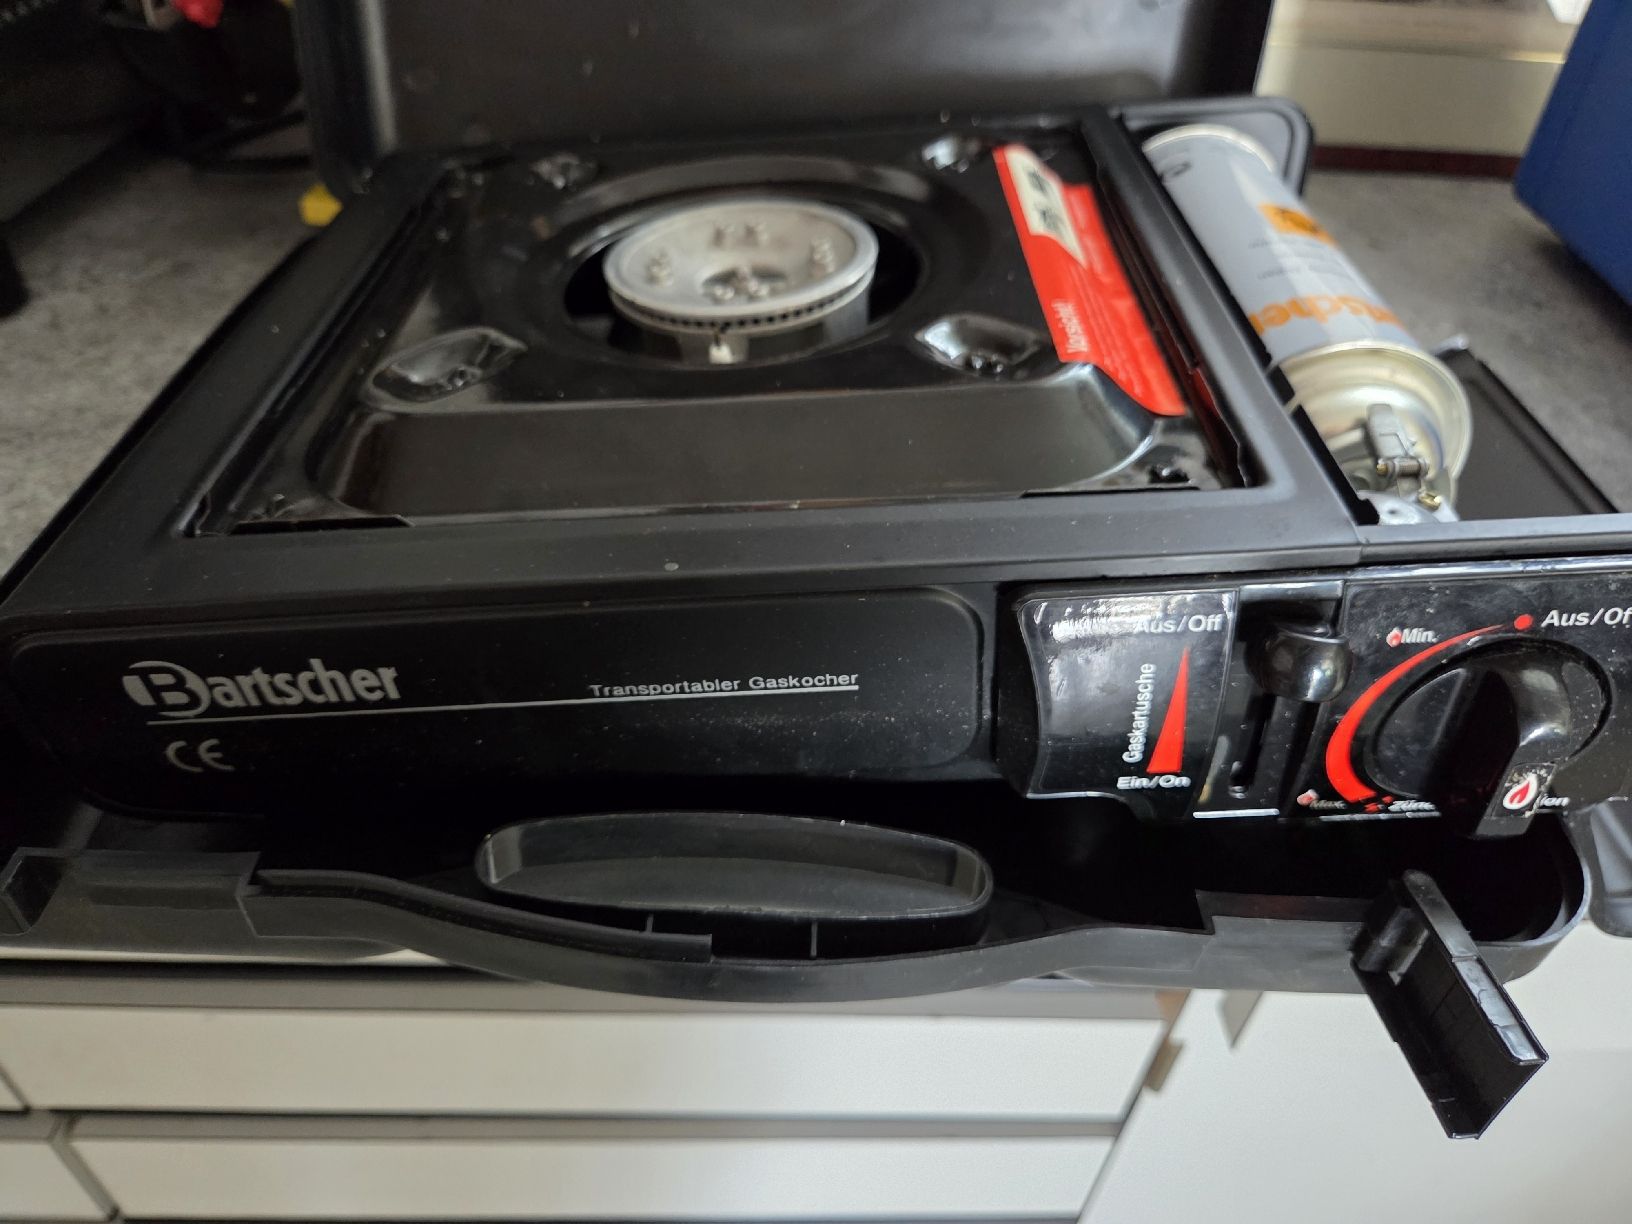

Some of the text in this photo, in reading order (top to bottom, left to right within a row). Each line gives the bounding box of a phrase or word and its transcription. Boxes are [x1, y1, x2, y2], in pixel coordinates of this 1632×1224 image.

[1133, 613, 1224, 634] Aus/Off
[1540, 607, 1632, 628] Aus/Of
[1400, 627, 1438, 644] Min.
[122, 658, 401, 718] Bartscher
[588, 673, 859, 697] Transportabler Gaskocher
[1121, 662, 1158, 764] Gaskartusche
[1116, 774, 1192, 791] Ein/On
